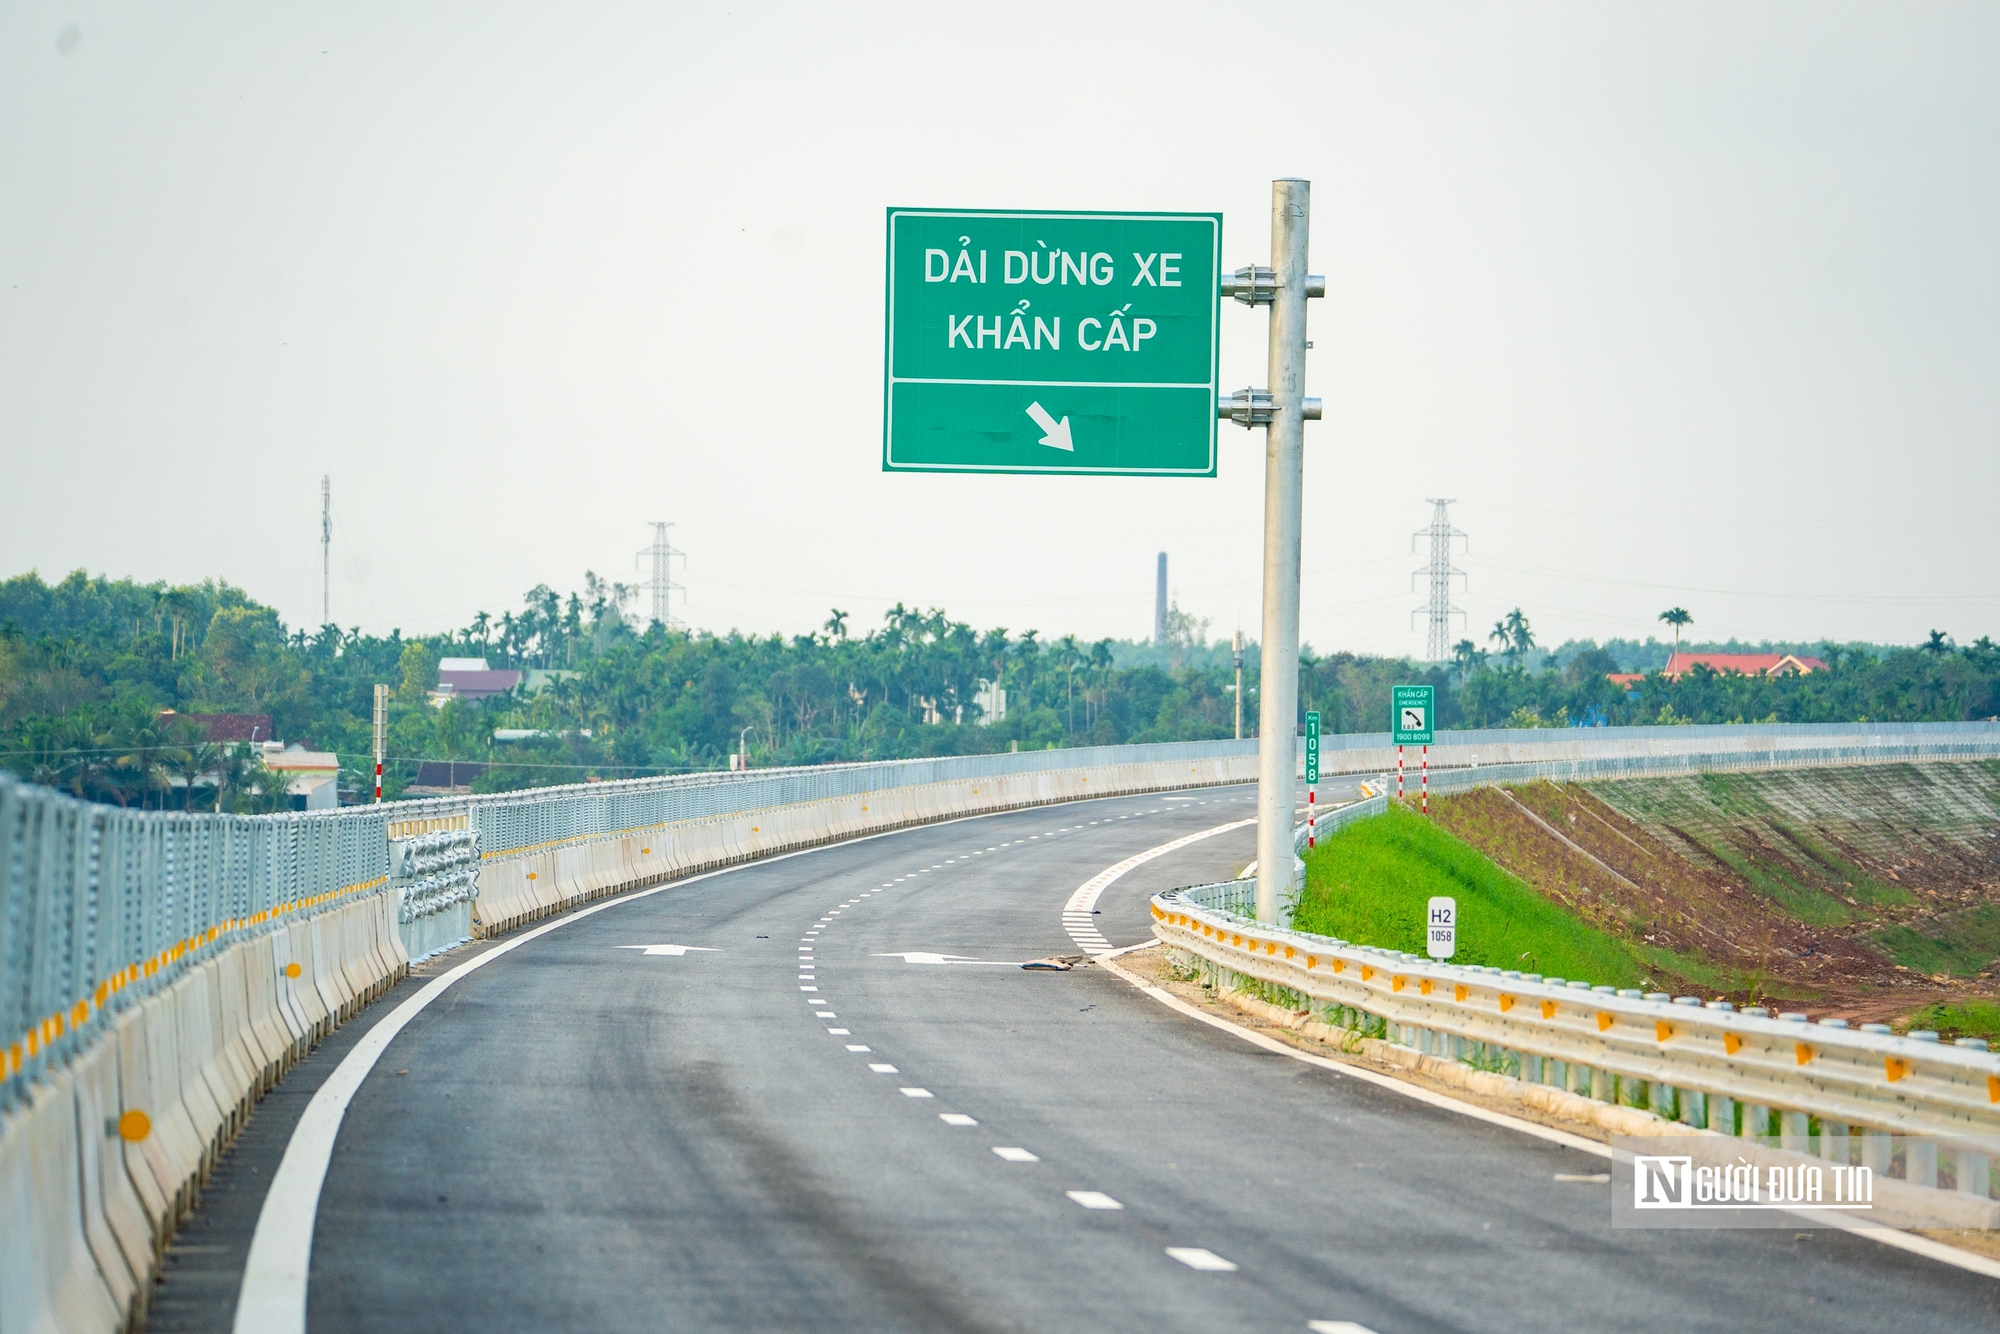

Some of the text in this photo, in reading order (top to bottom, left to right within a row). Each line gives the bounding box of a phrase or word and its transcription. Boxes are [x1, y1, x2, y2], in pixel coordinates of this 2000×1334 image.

[924, 235, 1182, 288] DẢI DỪNG XE
[948, 299, 1157, 352] KHẨN CẤP
[1308, 723, 1316, 781] 1058
[1431, 909, 1451, 923] H2
[1431, 930, 1452, 942] 1058
